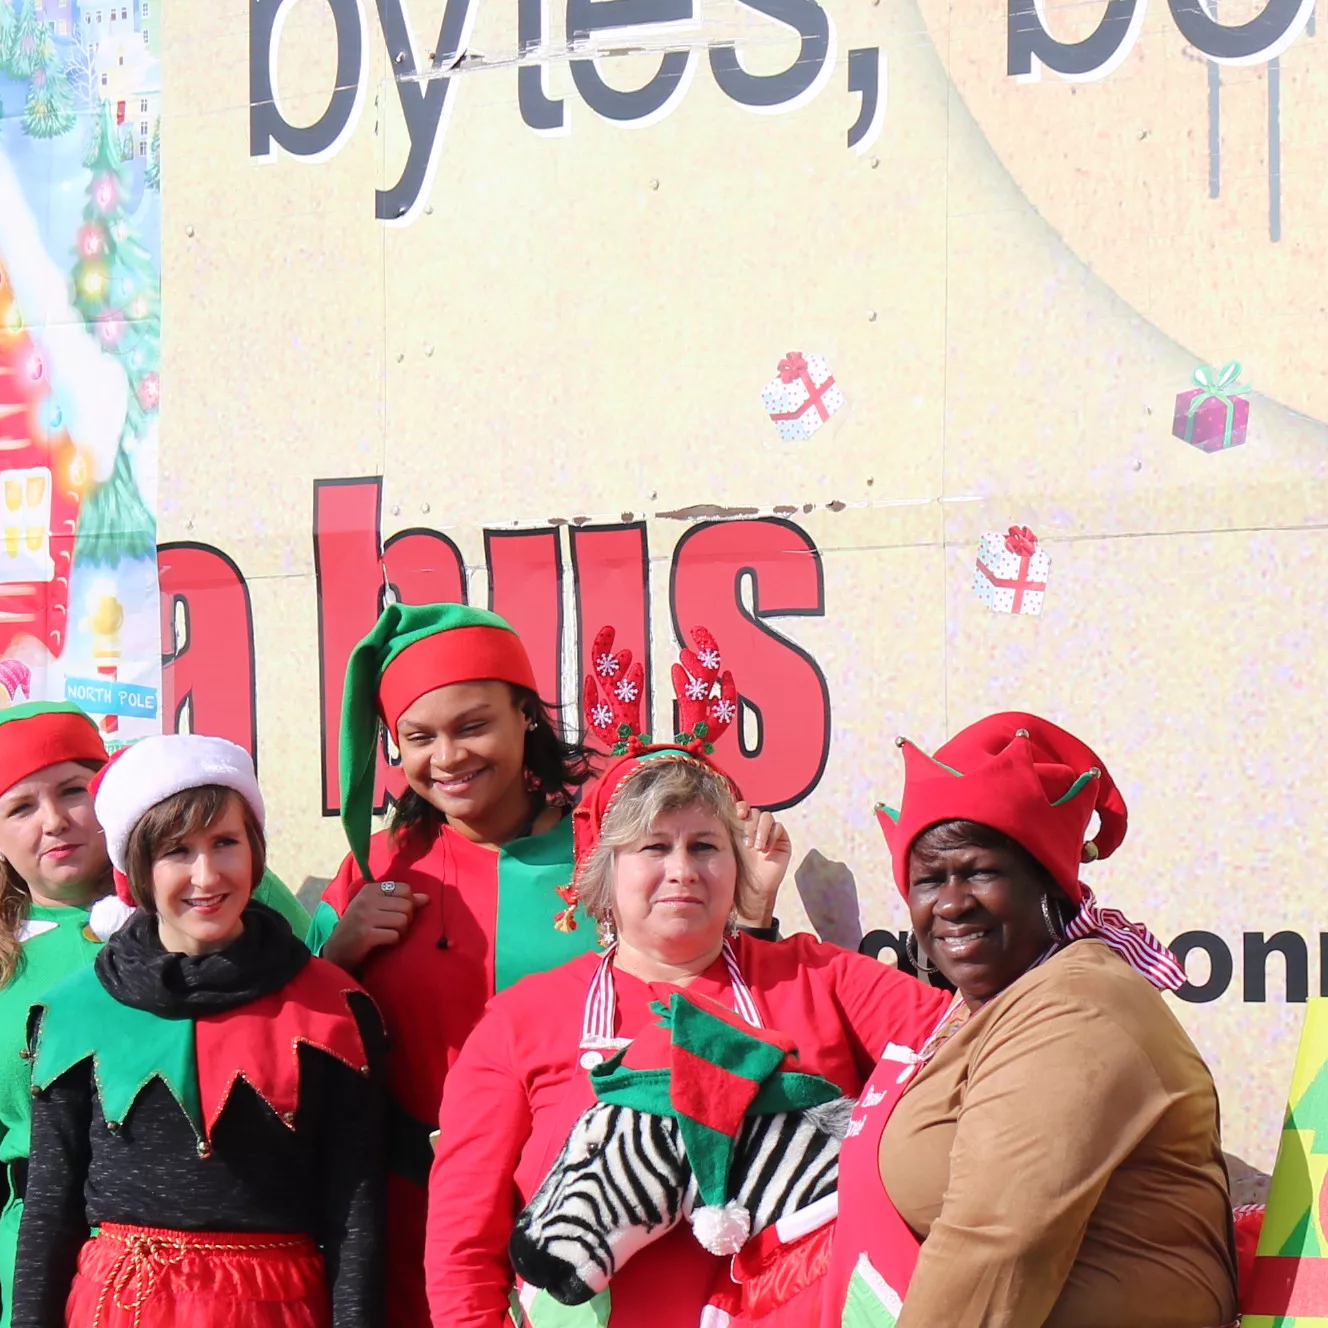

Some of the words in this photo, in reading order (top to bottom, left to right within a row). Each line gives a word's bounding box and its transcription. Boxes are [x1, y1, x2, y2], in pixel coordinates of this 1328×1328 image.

[67, 685, 112, 703] NORTH
[118, 690, 155, 709] POLE
[313, 475, 830, 818] bus
